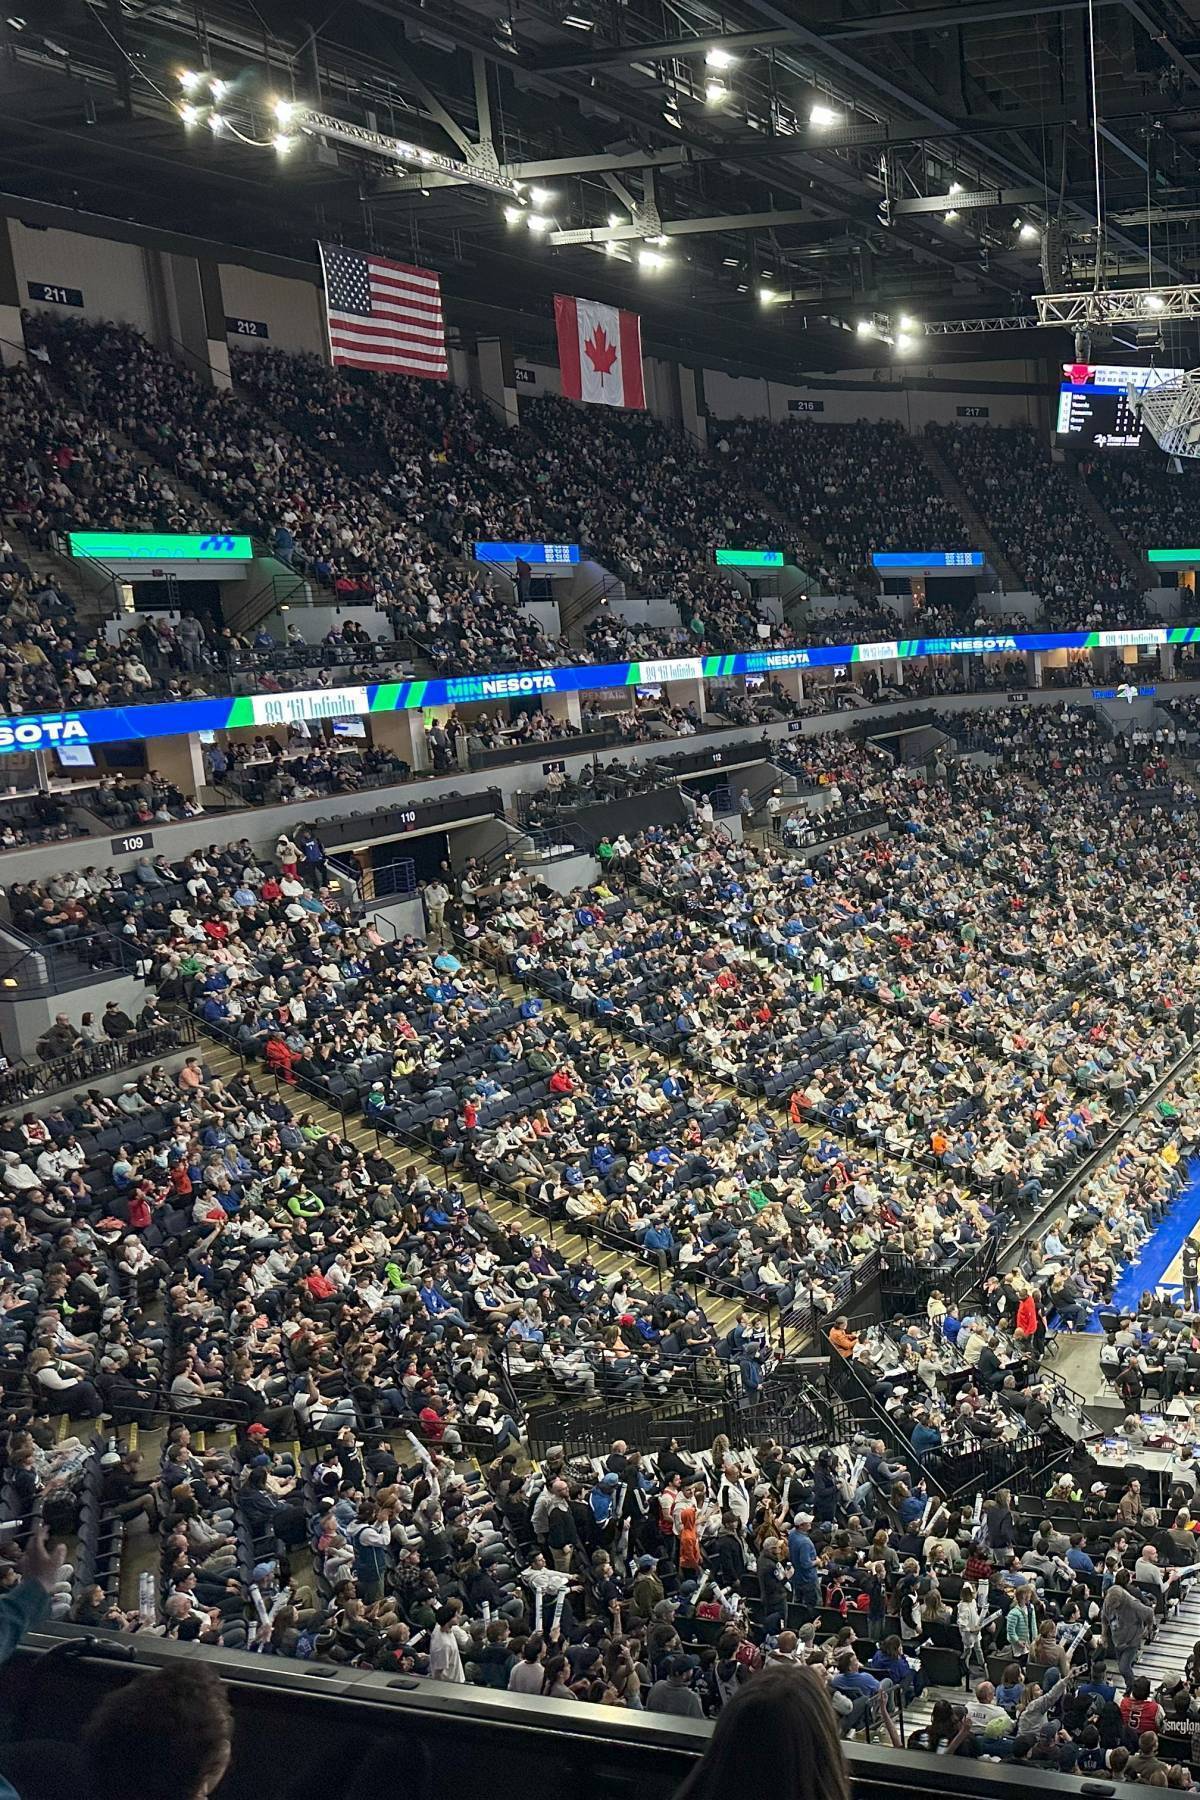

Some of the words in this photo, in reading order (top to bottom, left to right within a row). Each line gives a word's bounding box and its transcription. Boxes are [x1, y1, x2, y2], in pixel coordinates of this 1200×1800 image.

[44, 287, 67, 303] 211
[238, 321, 257, 335] 212
[515, 369, 528, 381] 214
[798, 402, 814, 411] 216
[965, 407, 980, 416] 217
[925, 639, 1017, 651] MINNESOTA
[746, 653, 810, 668] MINNESOTA
[448, 674, 557, 698] MINNESOTA
[400, 811, 415, 823] 110
[122, 837, 144, 851] 109
[1128, 1710, 1142, 1730] 5
